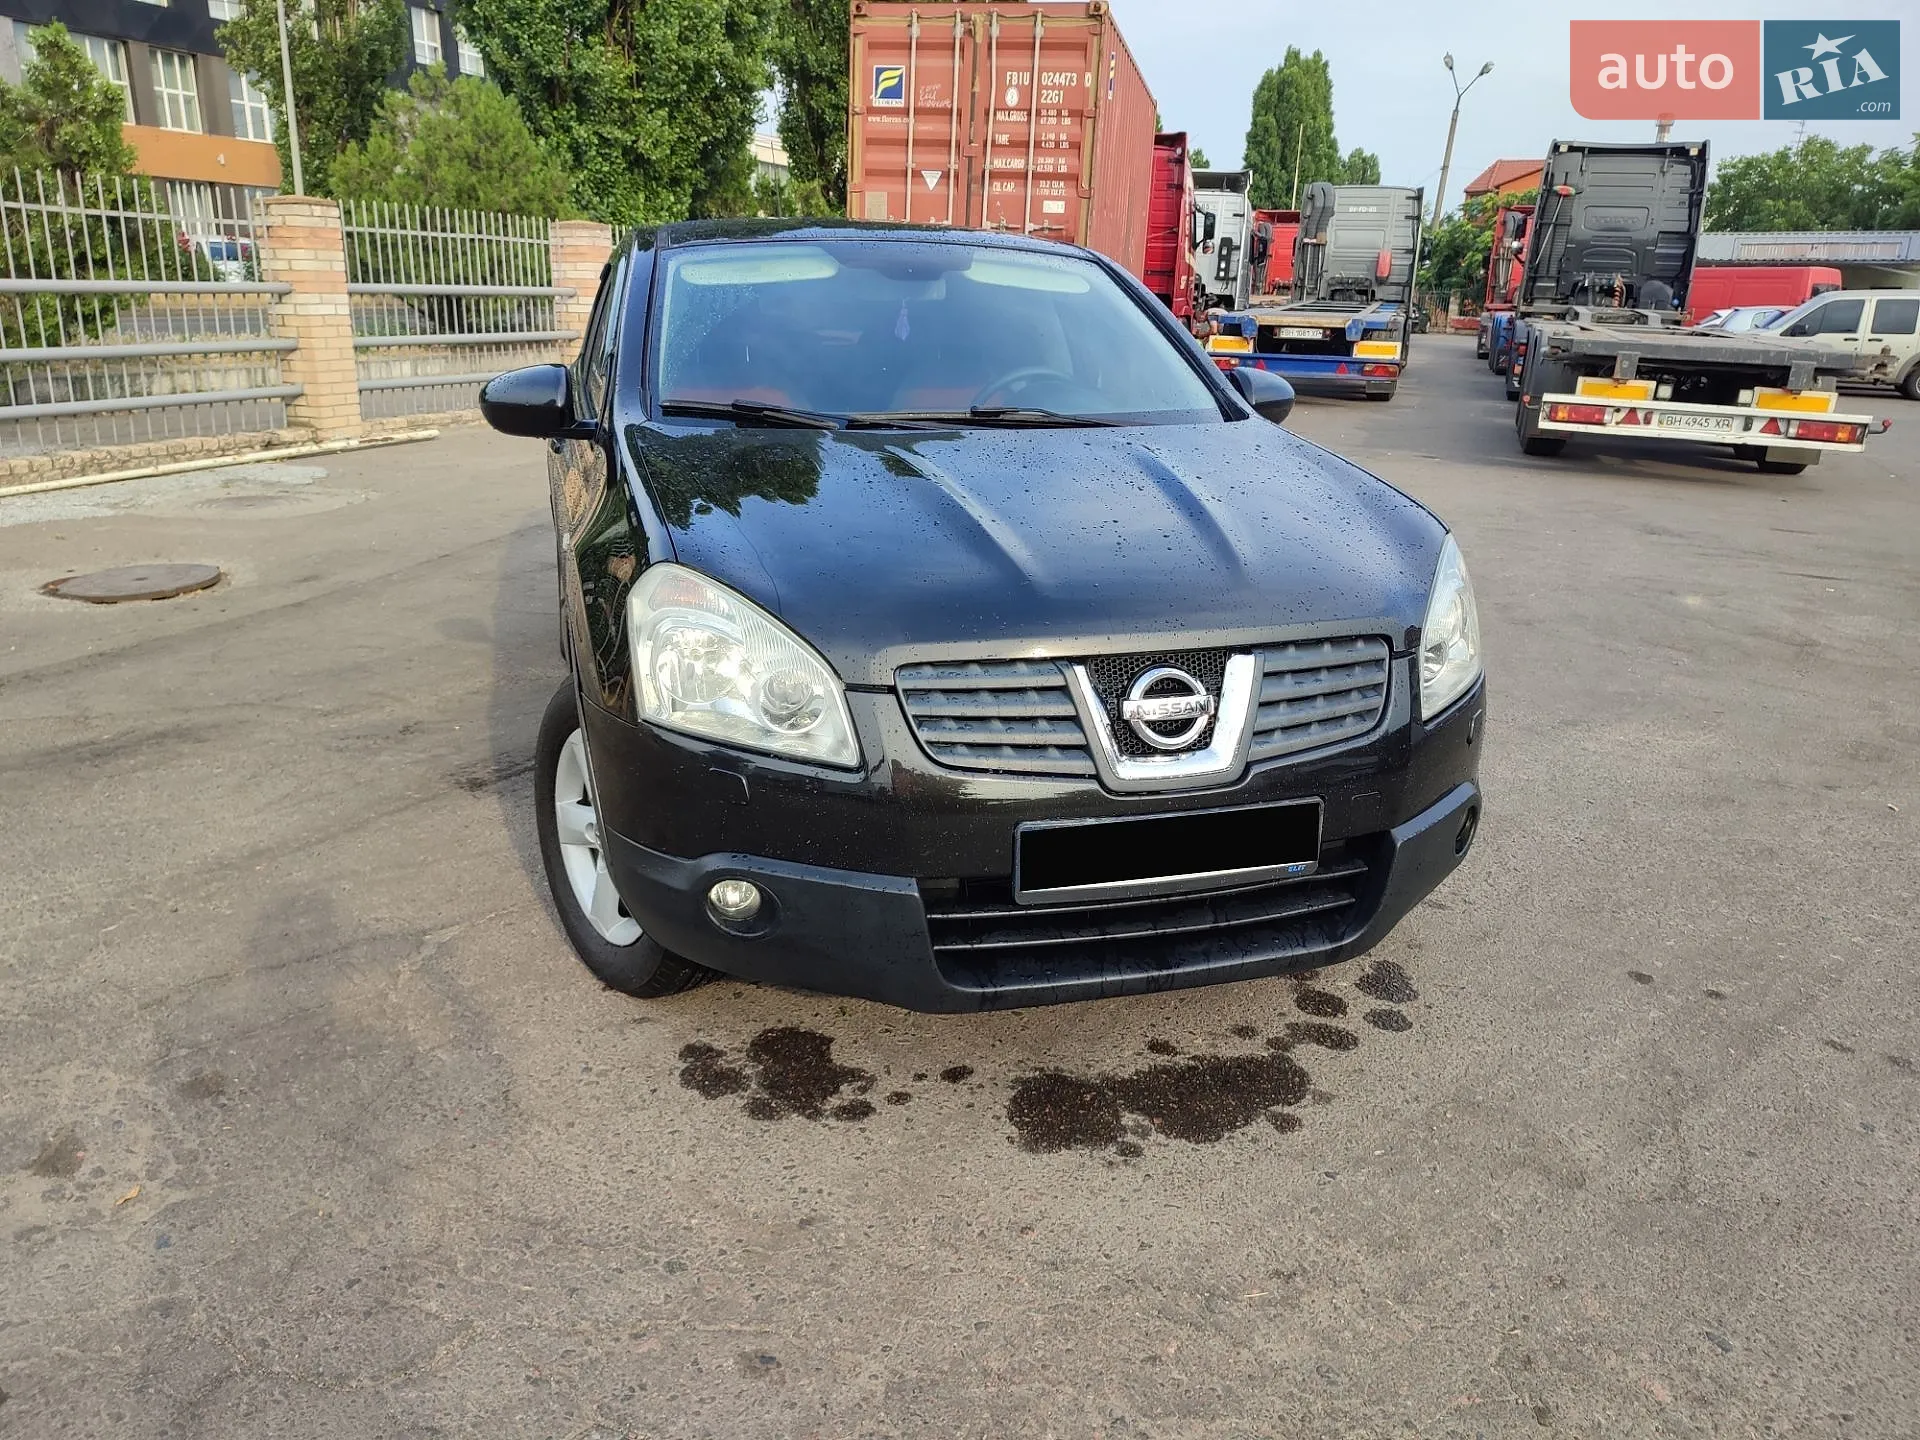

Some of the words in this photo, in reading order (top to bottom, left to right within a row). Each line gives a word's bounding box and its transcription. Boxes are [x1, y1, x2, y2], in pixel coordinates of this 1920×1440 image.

[1041, 71, 1078, 87] 024473
[1084, 71, 1092, 88] 0
[1040, 89, 1065, 104] 22G1
[995, 134, 1010, 145] TARE
[1666, 416, 1683, 426] BH
[1685, 416, 1710, 428] 4945
[1136, 695, 1212, 717] NISSAN
